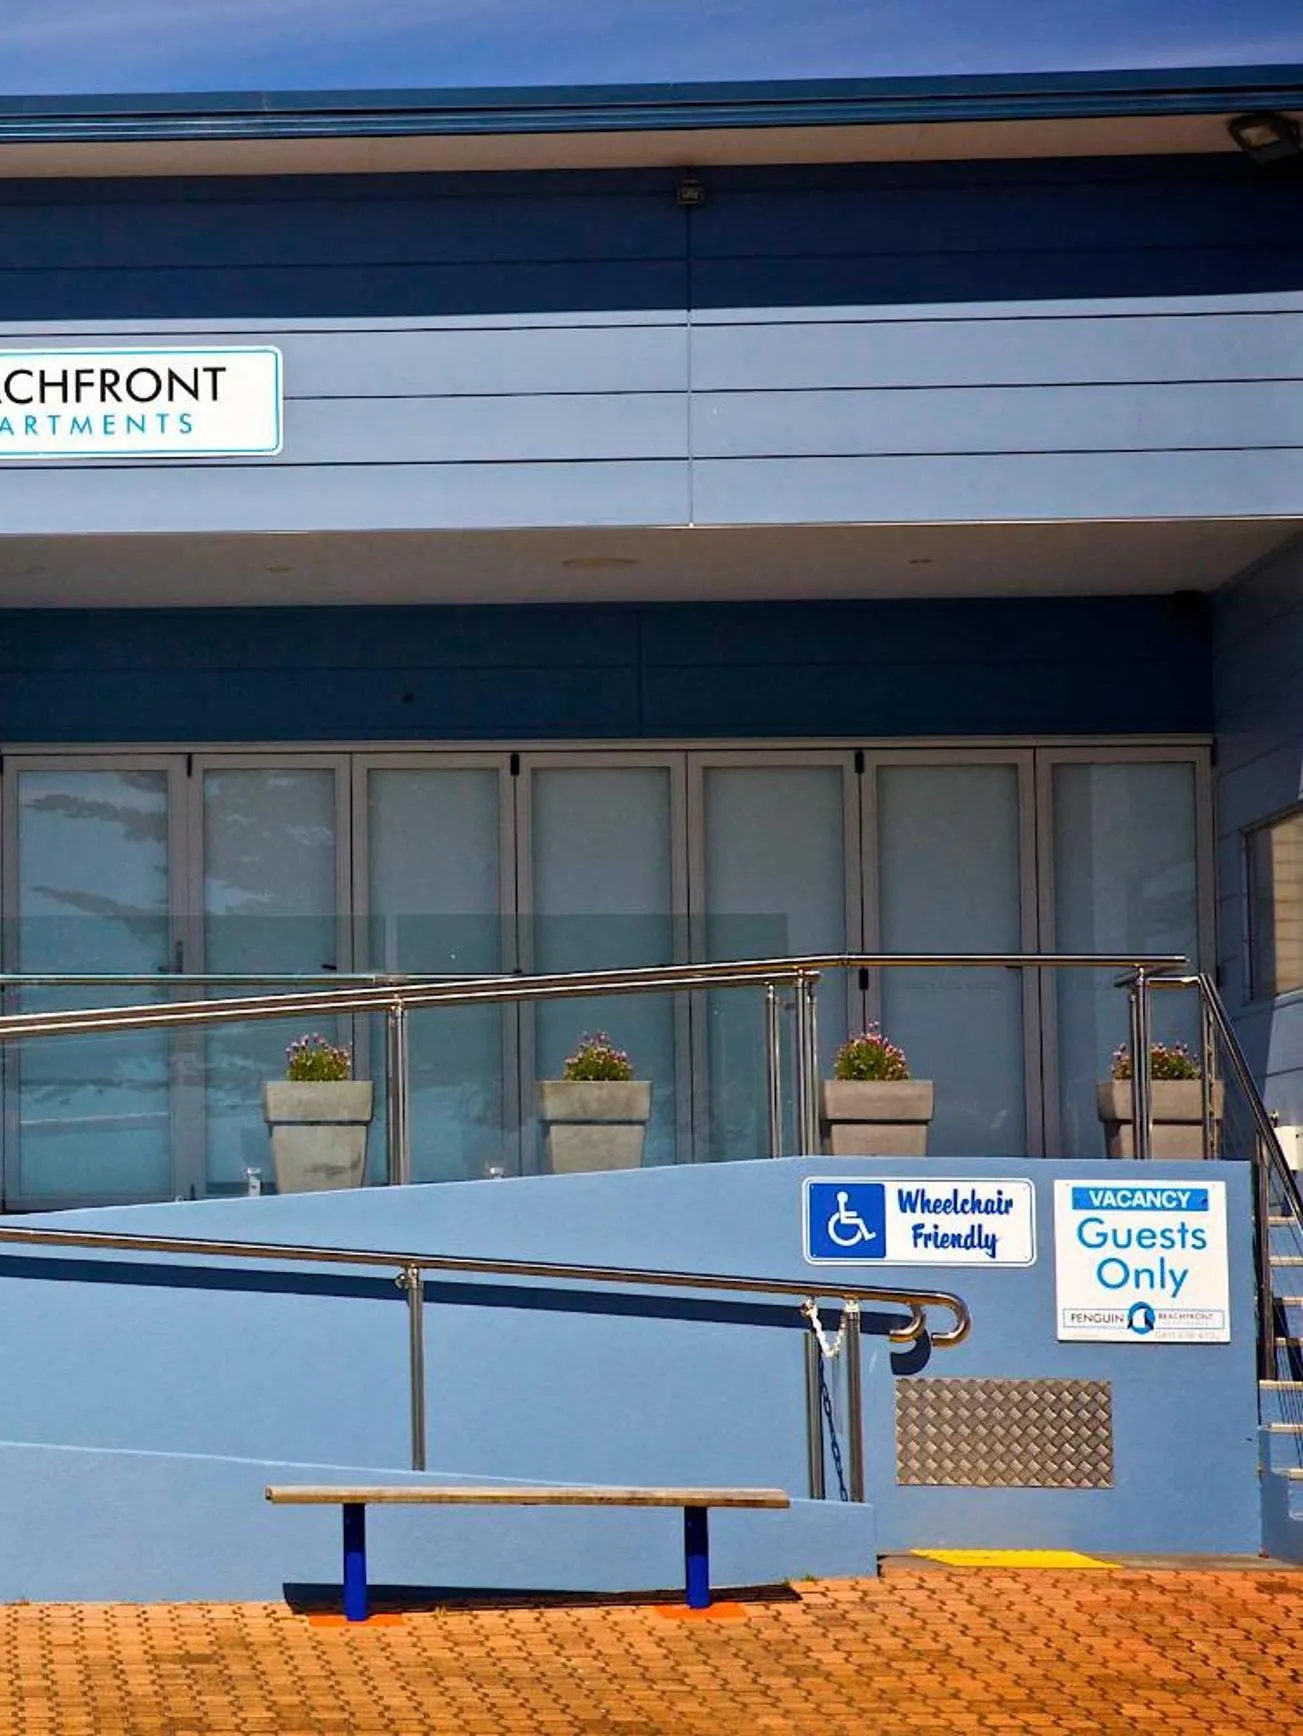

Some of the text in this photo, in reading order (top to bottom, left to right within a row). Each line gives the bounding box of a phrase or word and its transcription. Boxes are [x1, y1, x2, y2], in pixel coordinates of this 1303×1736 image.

[897, 1188, 1014, 1216] Wheelchair
[1089, 1189, 1191, 1208] VACANCY
[912, 1223, 997, 1259] Friendly
[1077, 1217, 1207, 1251] Guests
[1096, 1257, 1189, 1298] Only
[1071, 1313, 1124, 1324] PENGUIN
